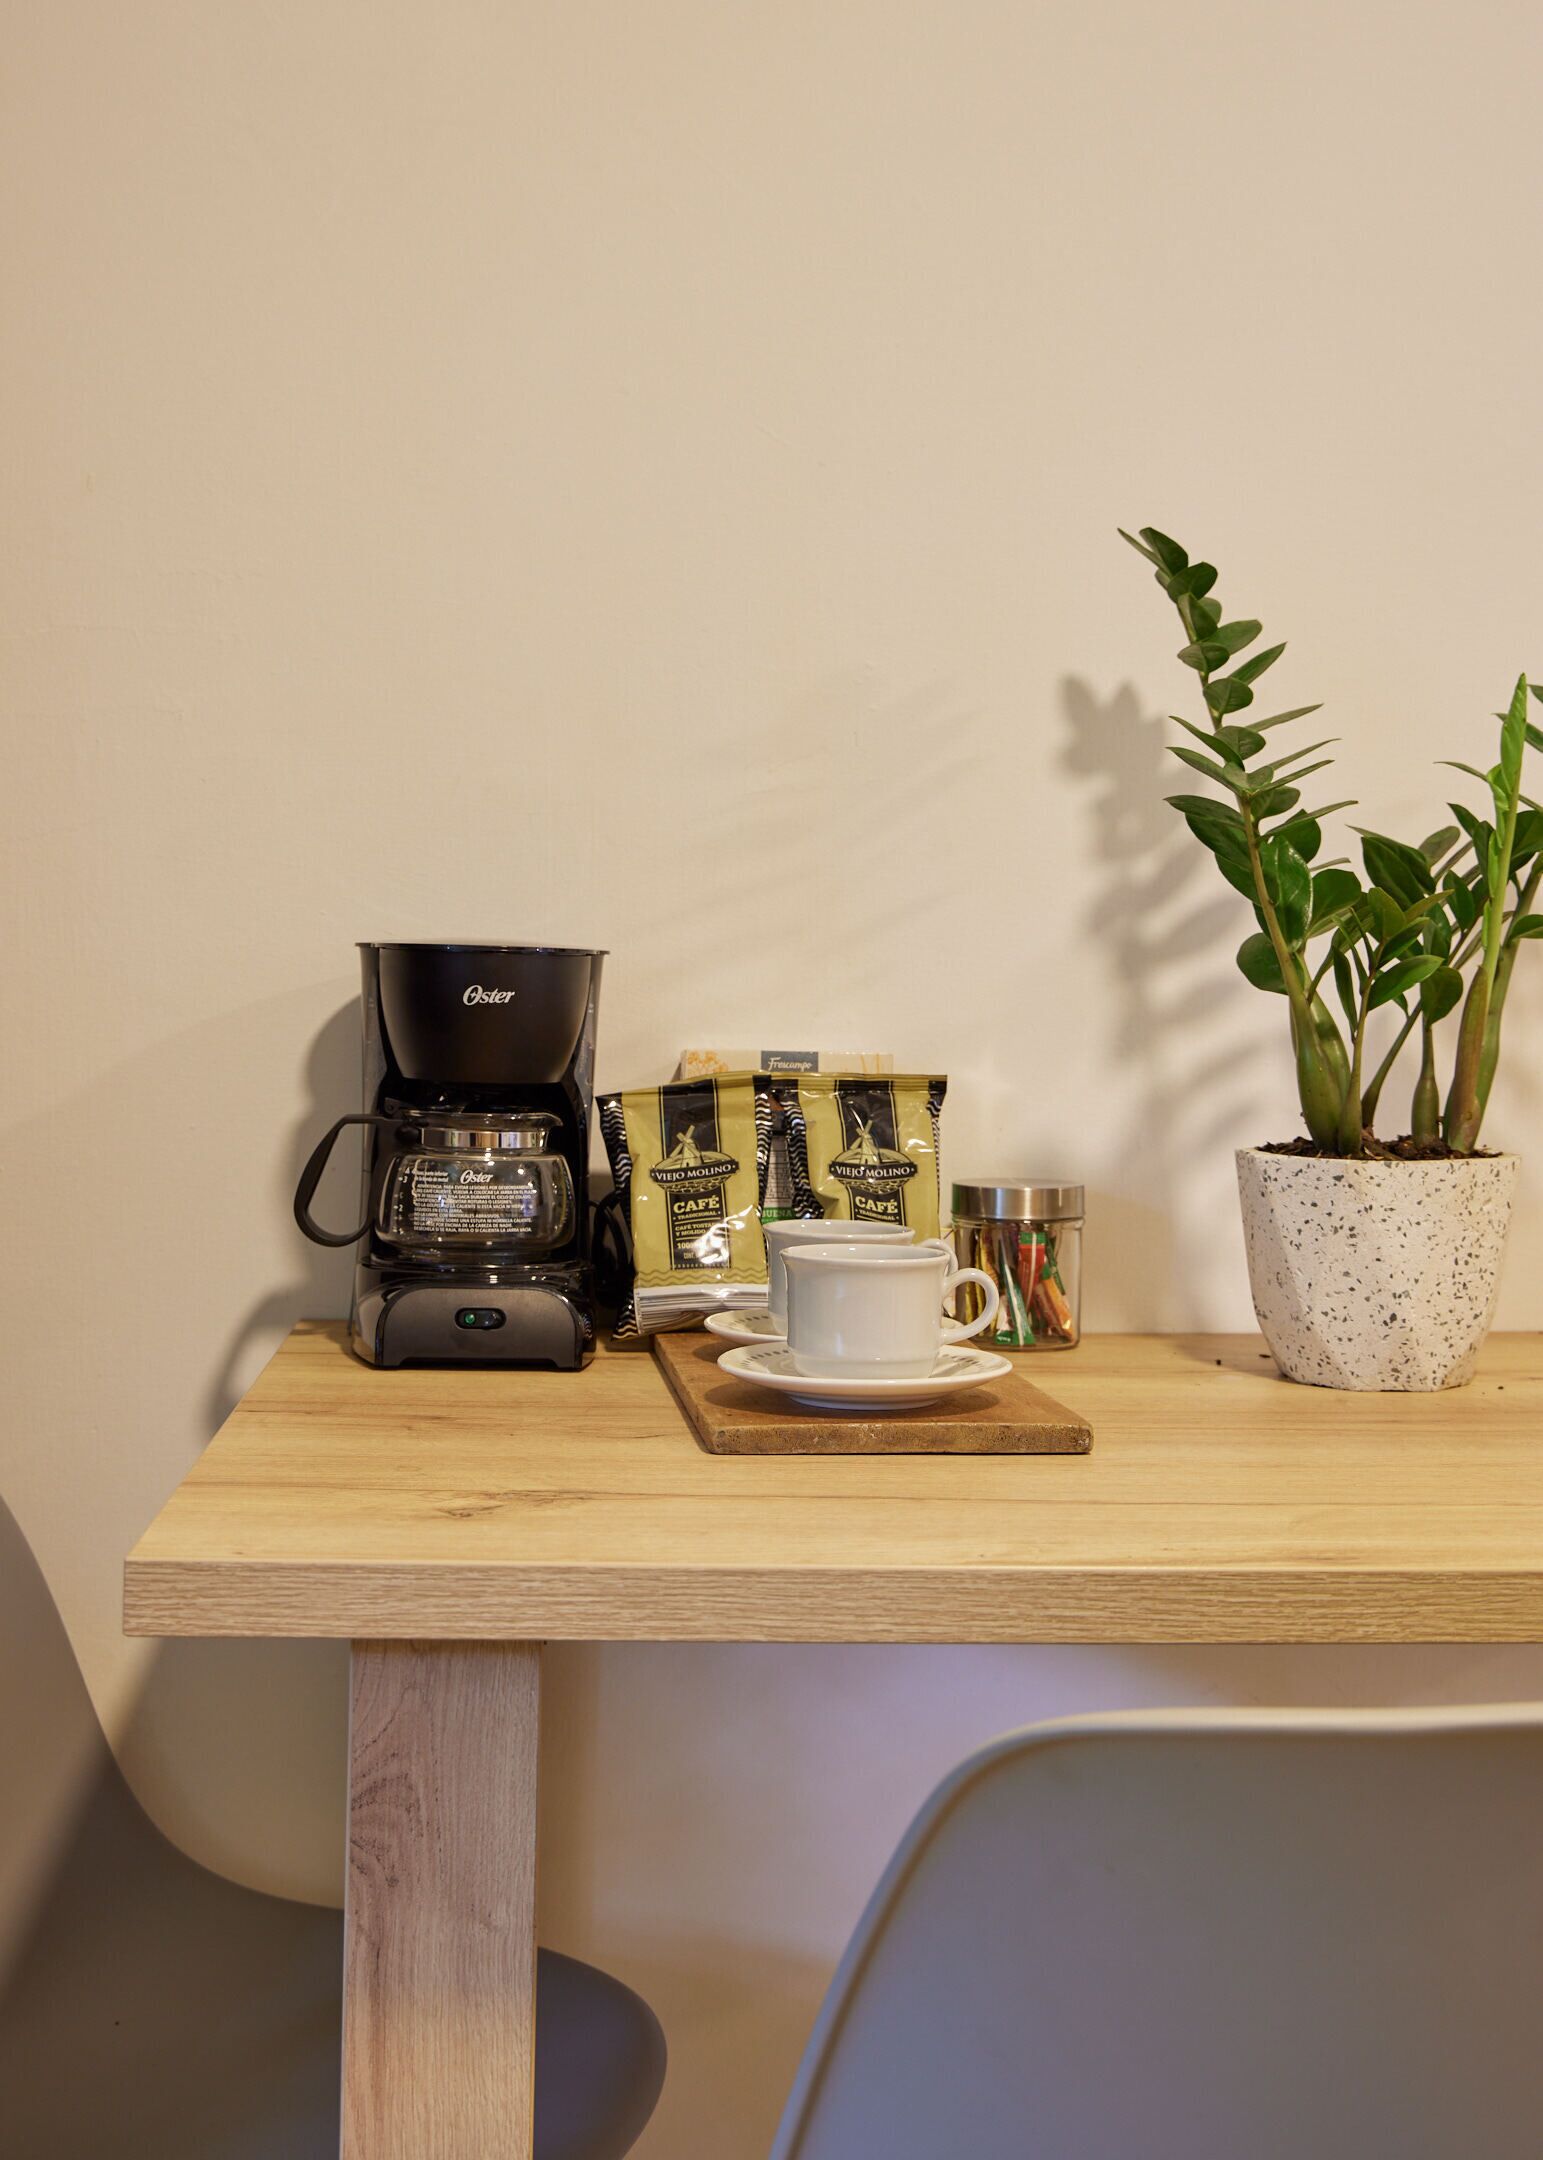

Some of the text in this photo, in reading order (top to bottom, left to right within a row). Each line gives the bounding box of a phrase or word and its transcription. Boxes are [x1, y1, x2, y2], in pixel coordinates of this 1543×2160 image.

[462, 984, 515, 1006] Oster
[768, 1057, 813, 1072] Frescampo
[460, 1169, 494, 1184] Oster
[655, 1164, 731, 1181] VIEJO MOLINO
[835, 1165, 910, 1178] VIEJO MOLINO
[673, 1194, 720, 1214] CAFÉ
[855, 1196, 898, 1213] CAFÉ
[677, 1211, 717, 1220] TRADICIONAL
[859, 1209, 896, 1221] TRADICIONAL
[681, 1228, 706, 1236] MOLIDO
